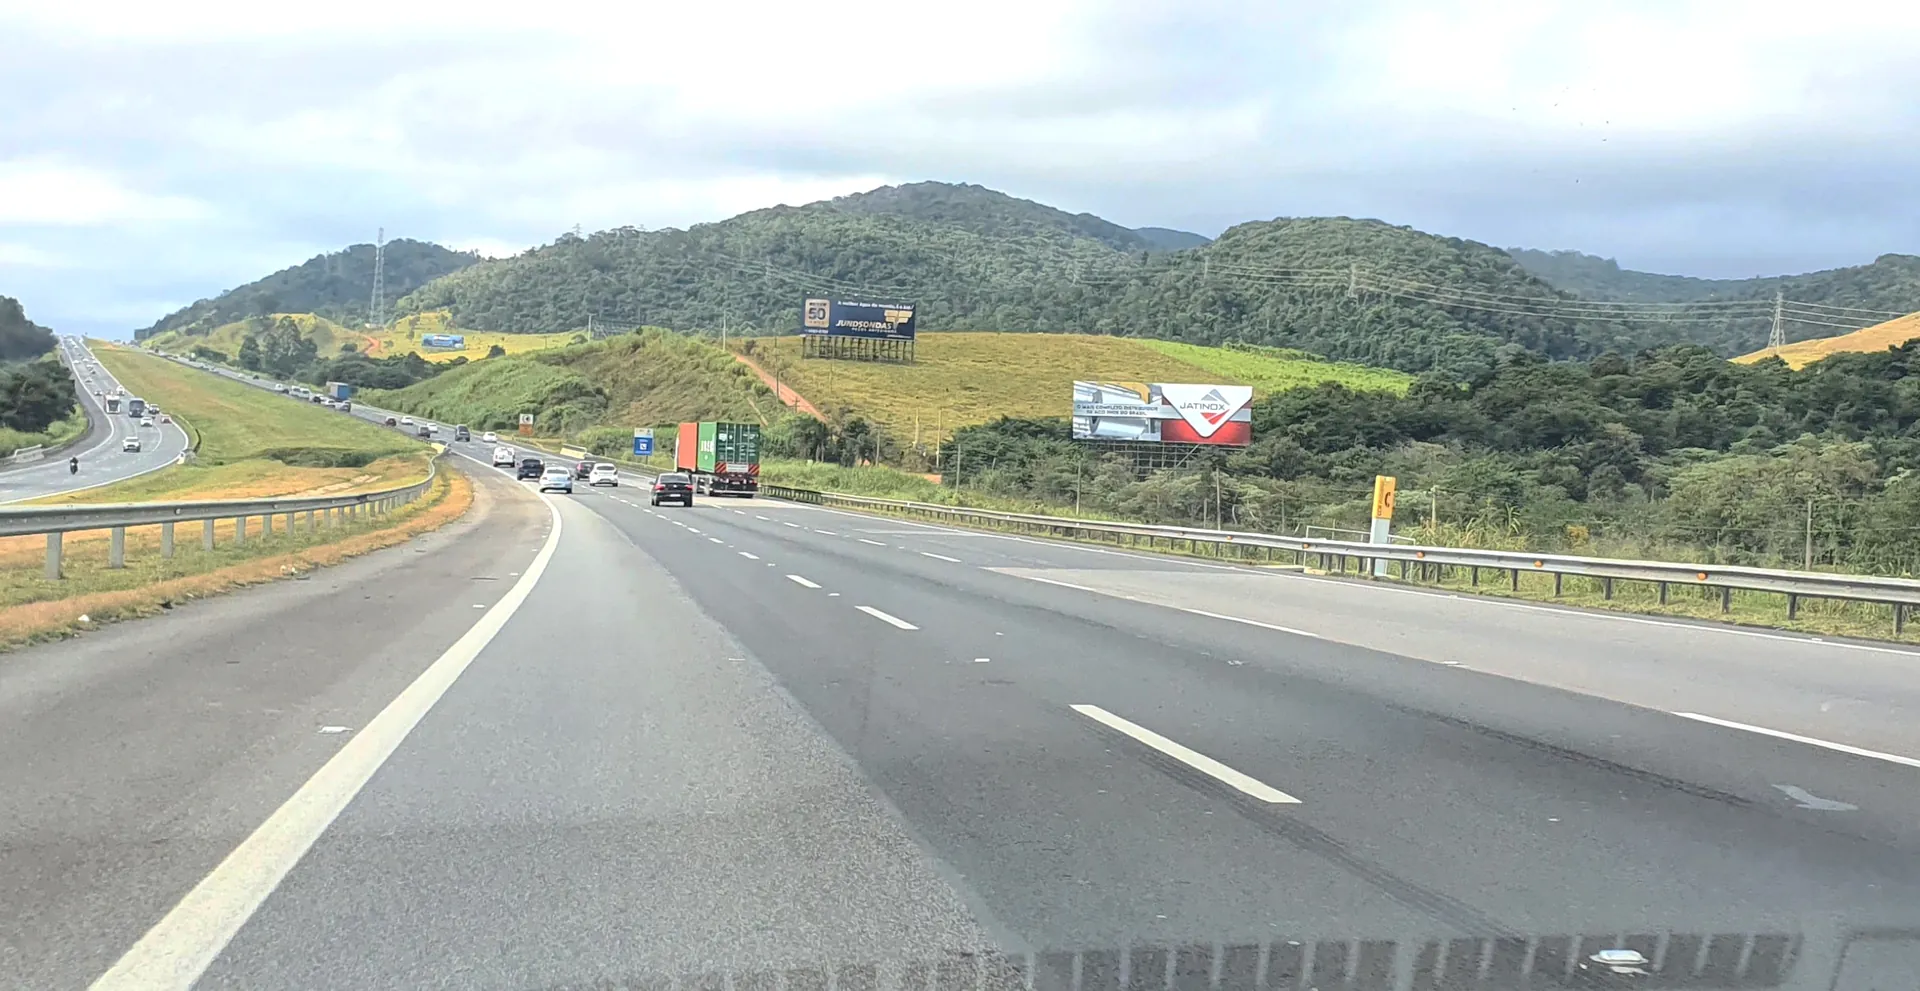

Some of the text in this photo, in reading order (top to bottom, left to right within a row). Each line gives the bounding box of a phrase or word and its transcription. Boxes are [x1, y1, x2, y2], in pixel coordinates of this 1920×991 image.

[808, 308, 826, 320] 50
[836, 320, 892, 330] JUNDSONDAS
[1180, 402, 1225, 411] JATINOX
